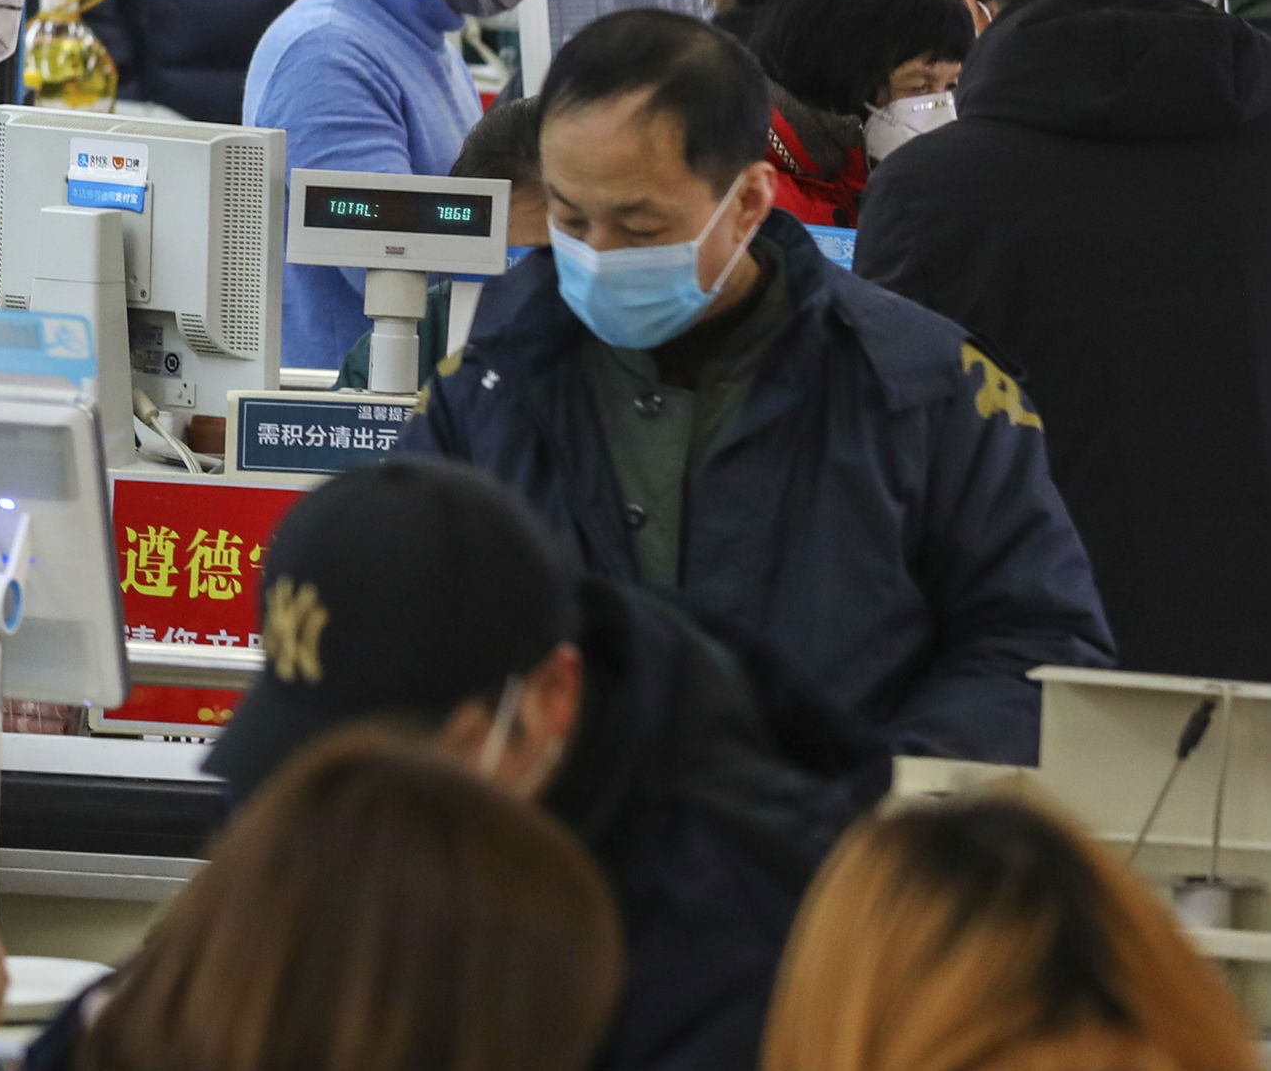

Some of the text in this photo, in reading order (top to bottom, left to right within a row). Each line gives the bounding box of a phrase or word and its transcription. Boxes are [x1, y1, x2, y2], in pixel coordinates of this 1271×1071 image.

[330, 200, 380, 218] TOTAL:
[258, 422, 399, 451] 需积分请出示
[120, 525, 268, 601] 遵德
